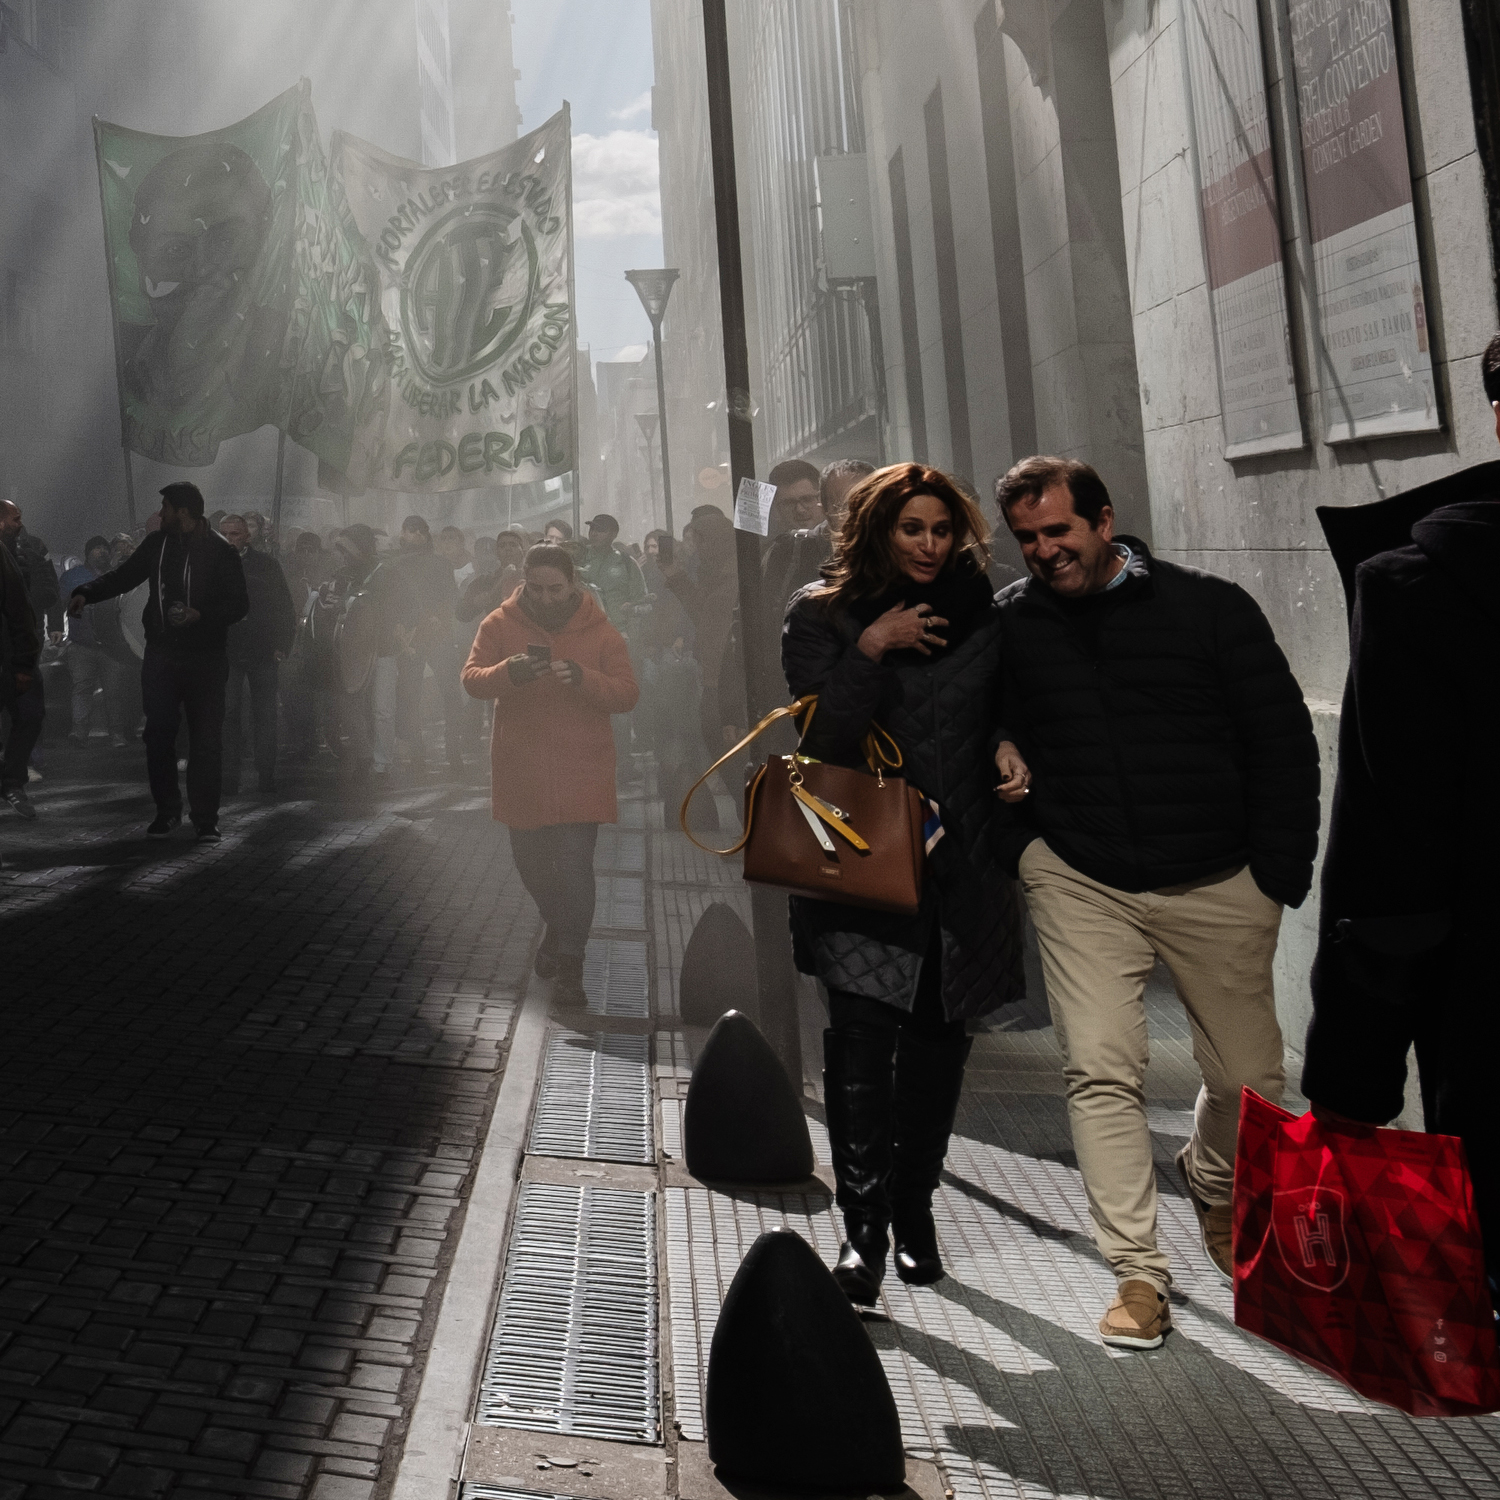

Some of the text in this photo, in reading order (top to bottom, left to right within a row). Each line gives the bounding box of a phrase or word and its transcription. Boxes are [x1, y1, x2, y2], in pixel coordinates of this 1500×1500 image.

[1324, 31, 1390, 108] CONVENTO
[1328, 17, 1345, 61] EL
[469, 377, 500, 414] LA
[502, 301, 569, 397] NACION
[392, 418, 566, 482] FEDERAL
